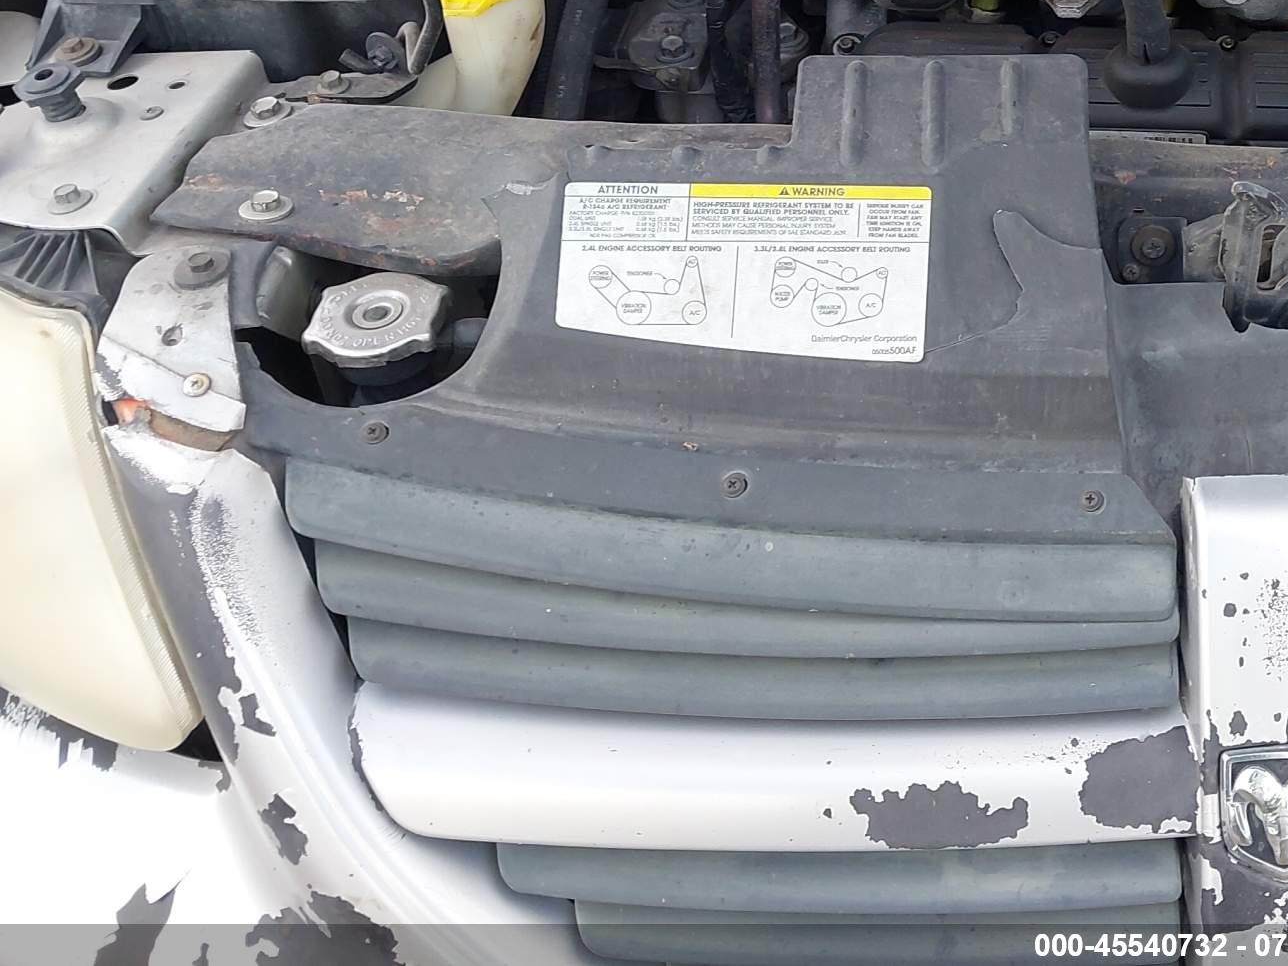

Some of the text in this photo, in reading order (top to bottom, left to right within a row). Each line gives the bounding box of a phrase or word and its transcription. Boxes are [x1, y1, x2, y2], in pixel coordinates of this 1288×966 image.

[598, 185, 659, 195] ATTENTION
[792, 188, 845, 196] WARNING
[811, 335, 918, 344] DaimlerChrysler Corporation
